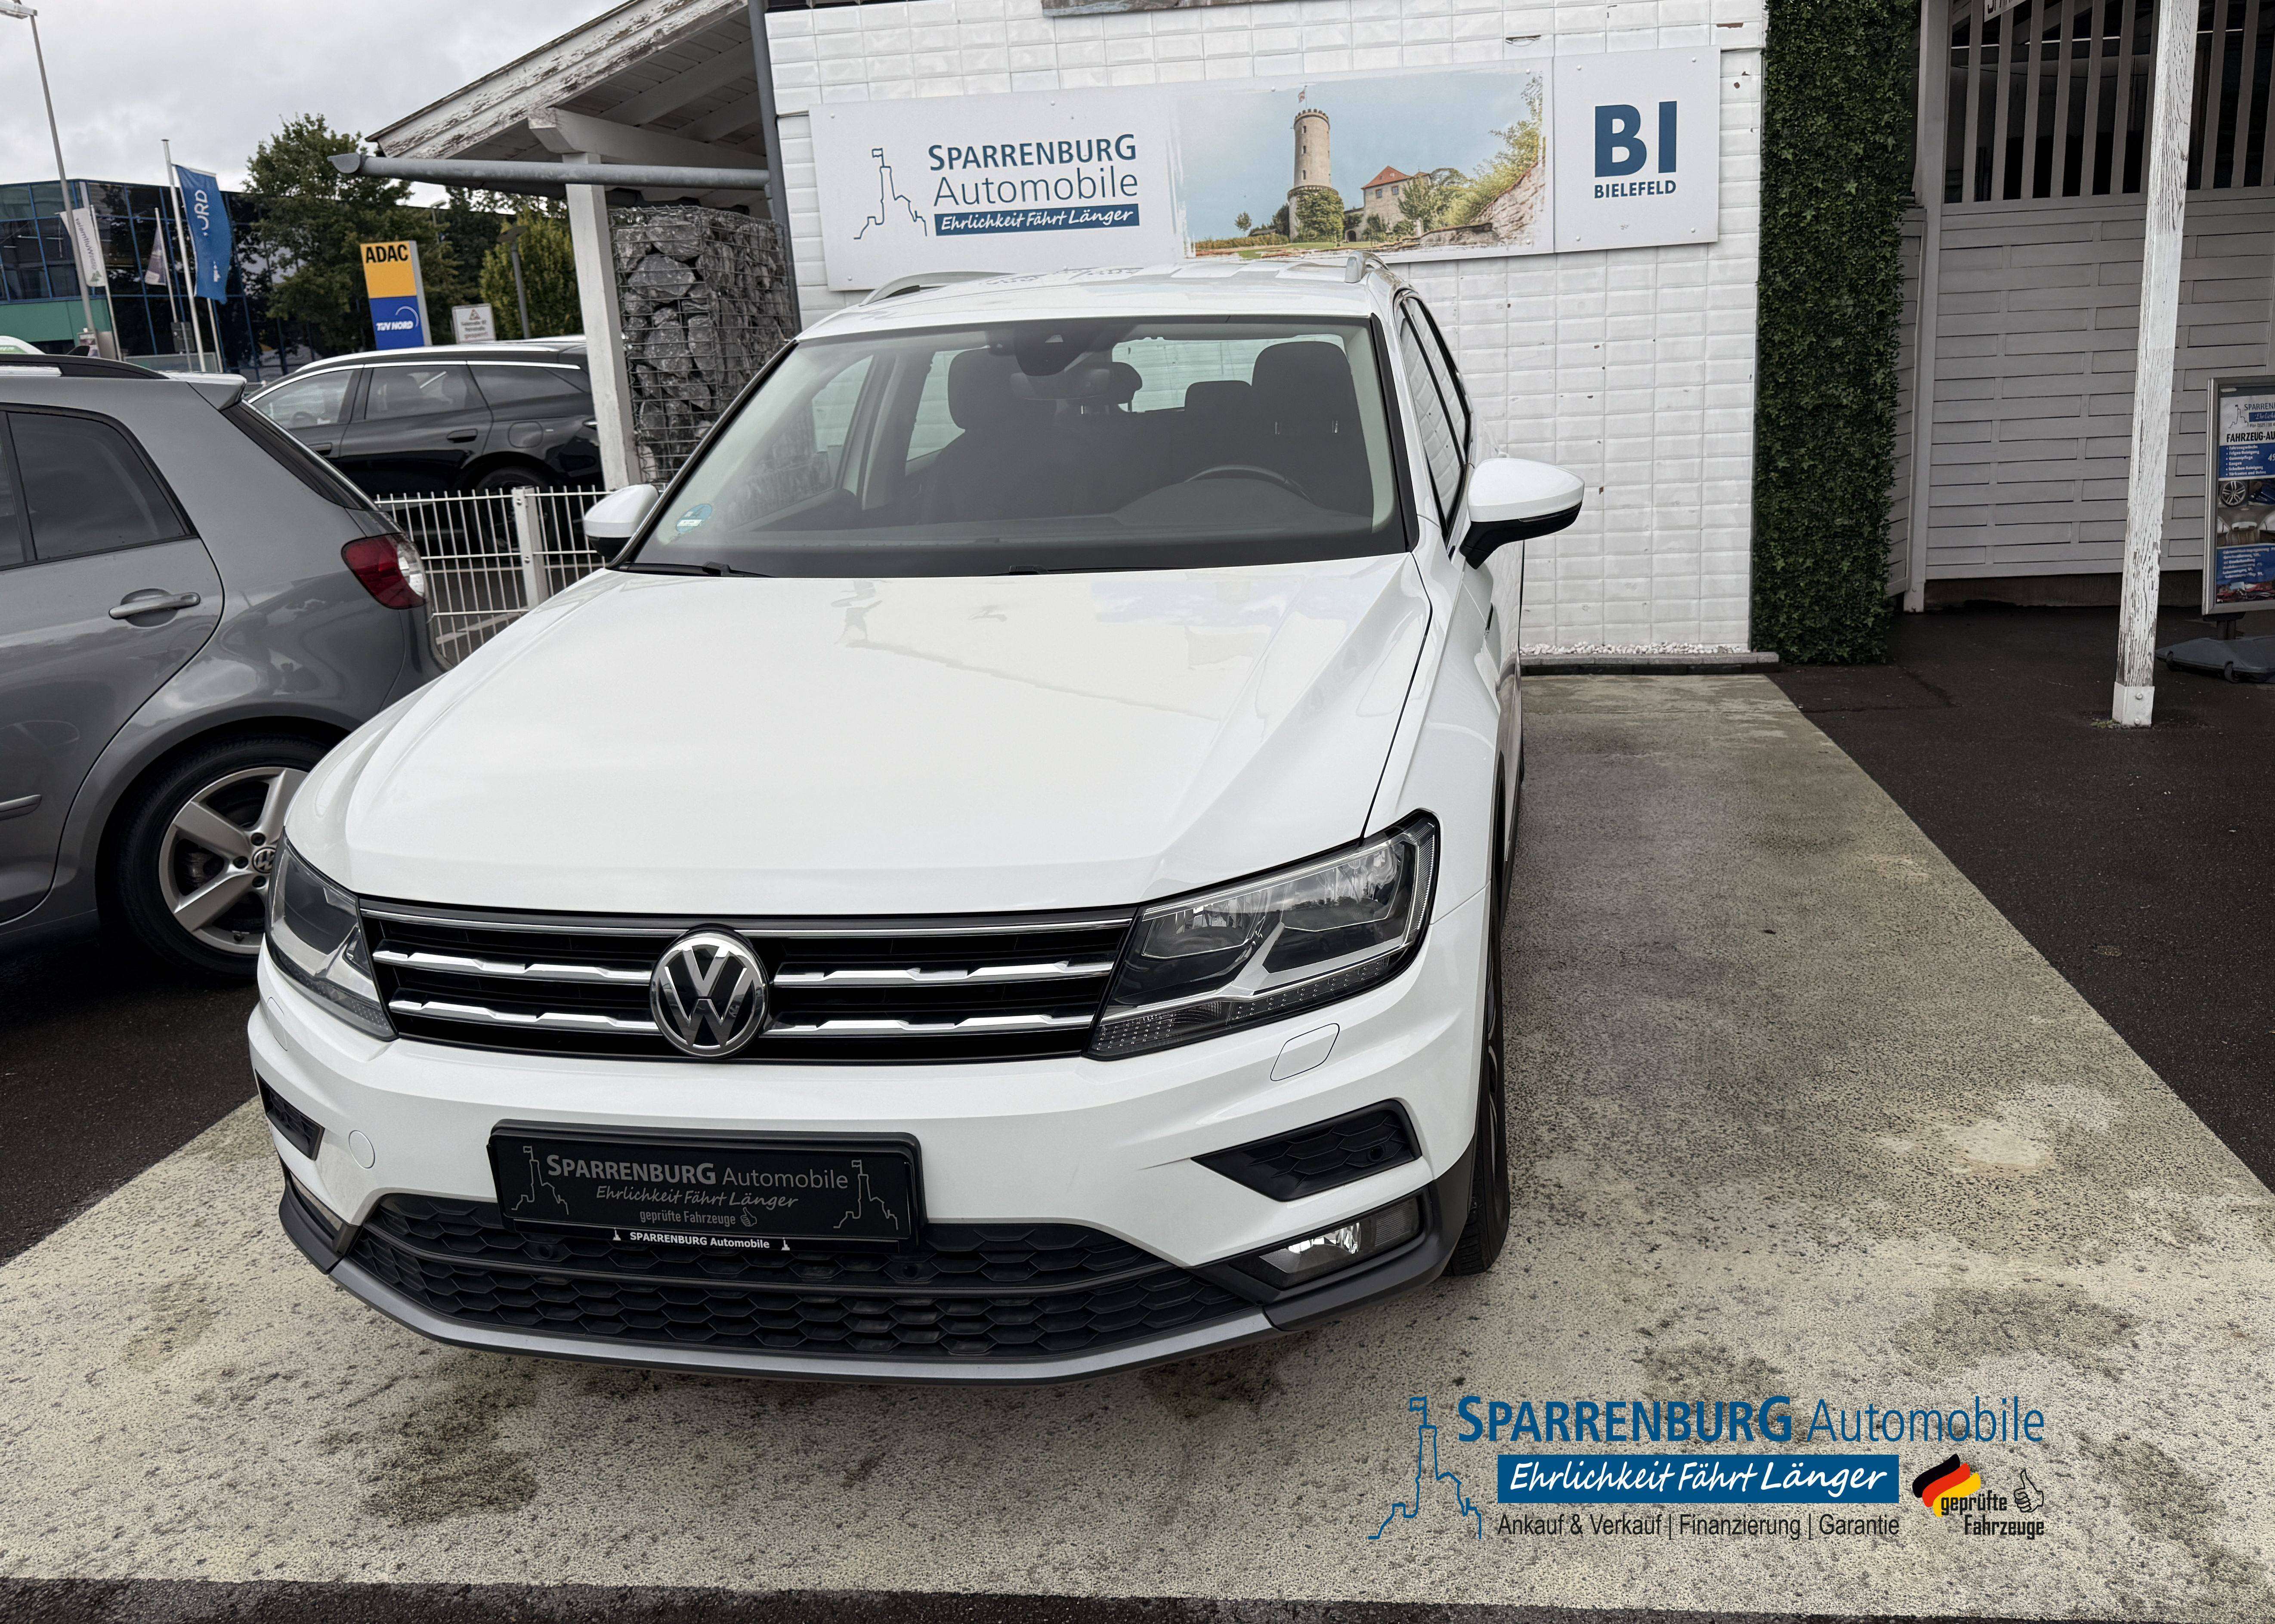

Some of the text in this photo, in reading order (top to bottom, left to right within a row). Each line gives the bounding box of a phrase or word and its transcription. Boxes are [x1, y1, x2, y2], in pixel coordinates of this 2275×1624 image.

[1595, 101, 1677, 177] BI
[929, 134, 1136, 171] SPARRENBURG
[933, 166, 1138, 207] Automobile
[1594, 180, 1676, 199] BIELEFELD
[941, 209, 1134, 230] Ehrlichkeit Fährt Länger
[366, 244, 408, 264] ADAC
[391, 320, 414, 330] NORD
[2244, 402, 2275, 411] SPARREN
[547, 1154, 848, 1189] SPARRENBURG Automobile
[597, 1185, 798, 1210] Ehrlichkeit Fährt Länger
[640, 1209, 736, 1228] geprüfte Fahrzeuge
[630, 1231, 770, 1249] SPARRENBURG Automobile
